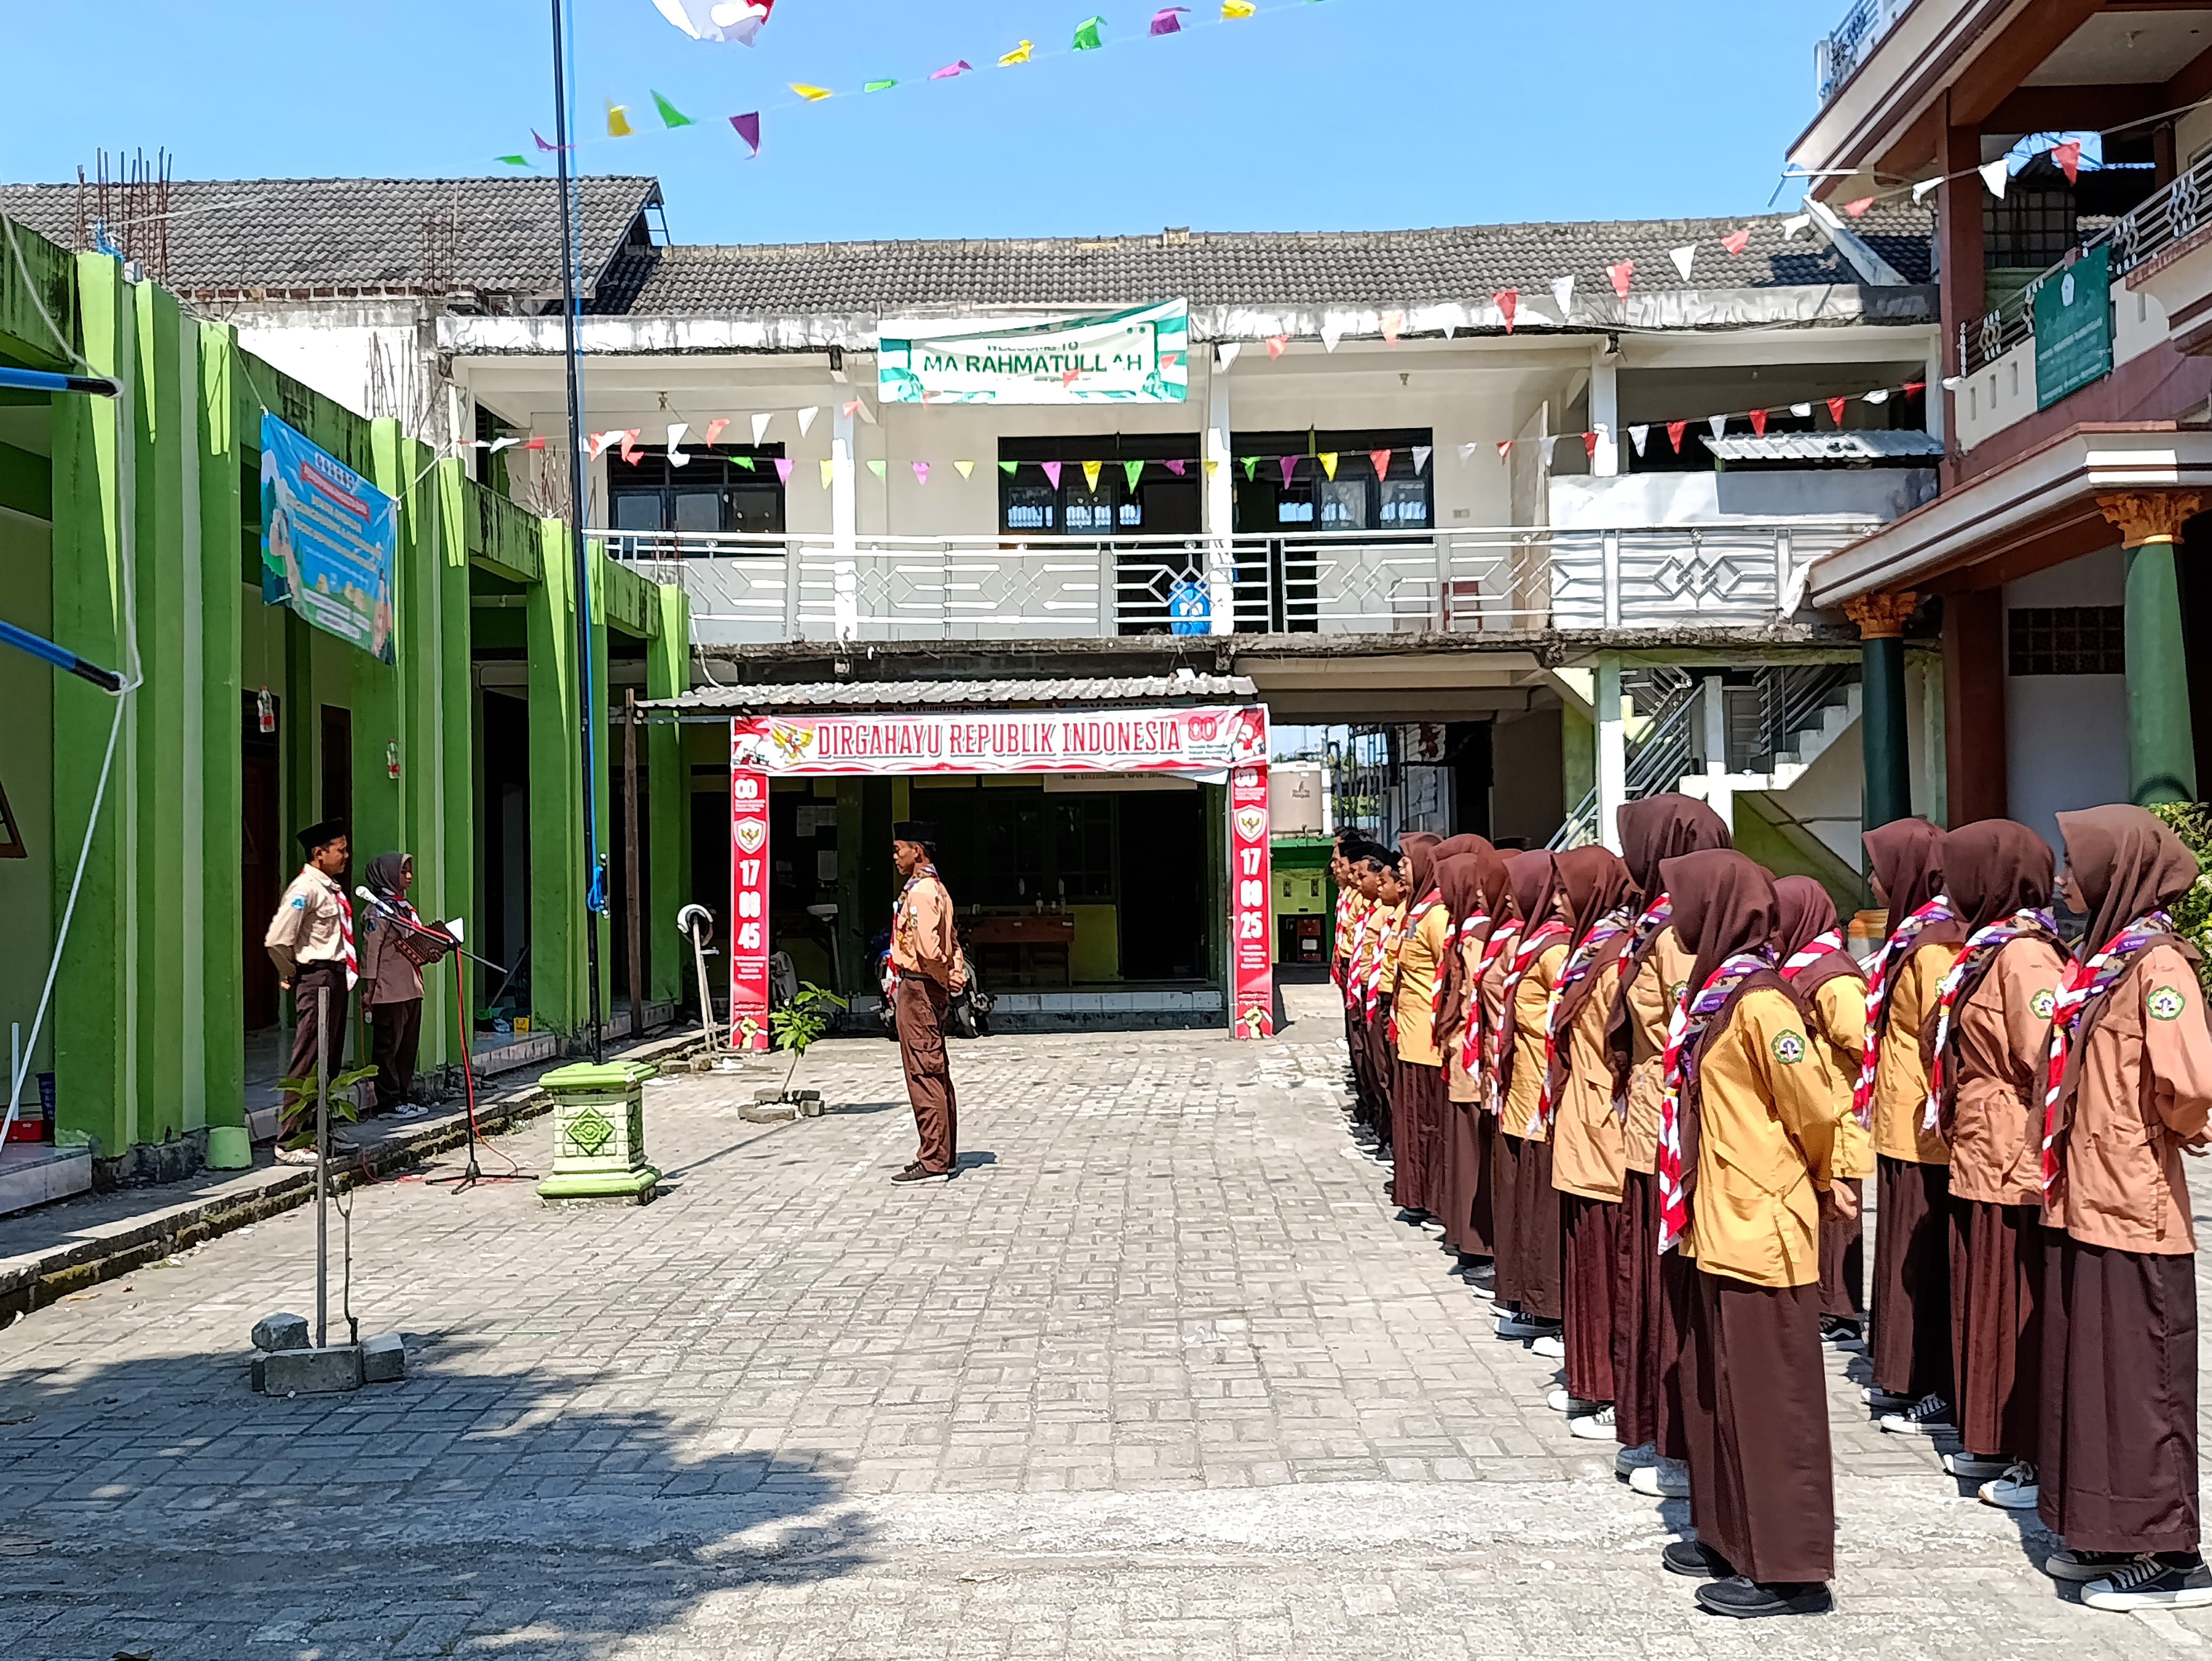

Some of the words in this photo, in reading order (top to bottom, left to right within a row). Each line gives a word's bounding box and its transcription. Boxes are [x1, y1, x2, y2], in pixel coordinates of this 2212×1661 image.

[924, 354, 958, 372] MA
[818, 724, 941, 757] DIRGAHAYU
[950, 722, 1055, 756] REPUBLIK
[1062, 720, 1182, 754] INDONESIA
[739, 858, 761, 887] 17
[1239, 847, 1262, 875] 17
[737, 922, 761, 949] 45
[1239, 911, 1263, 939] 25
